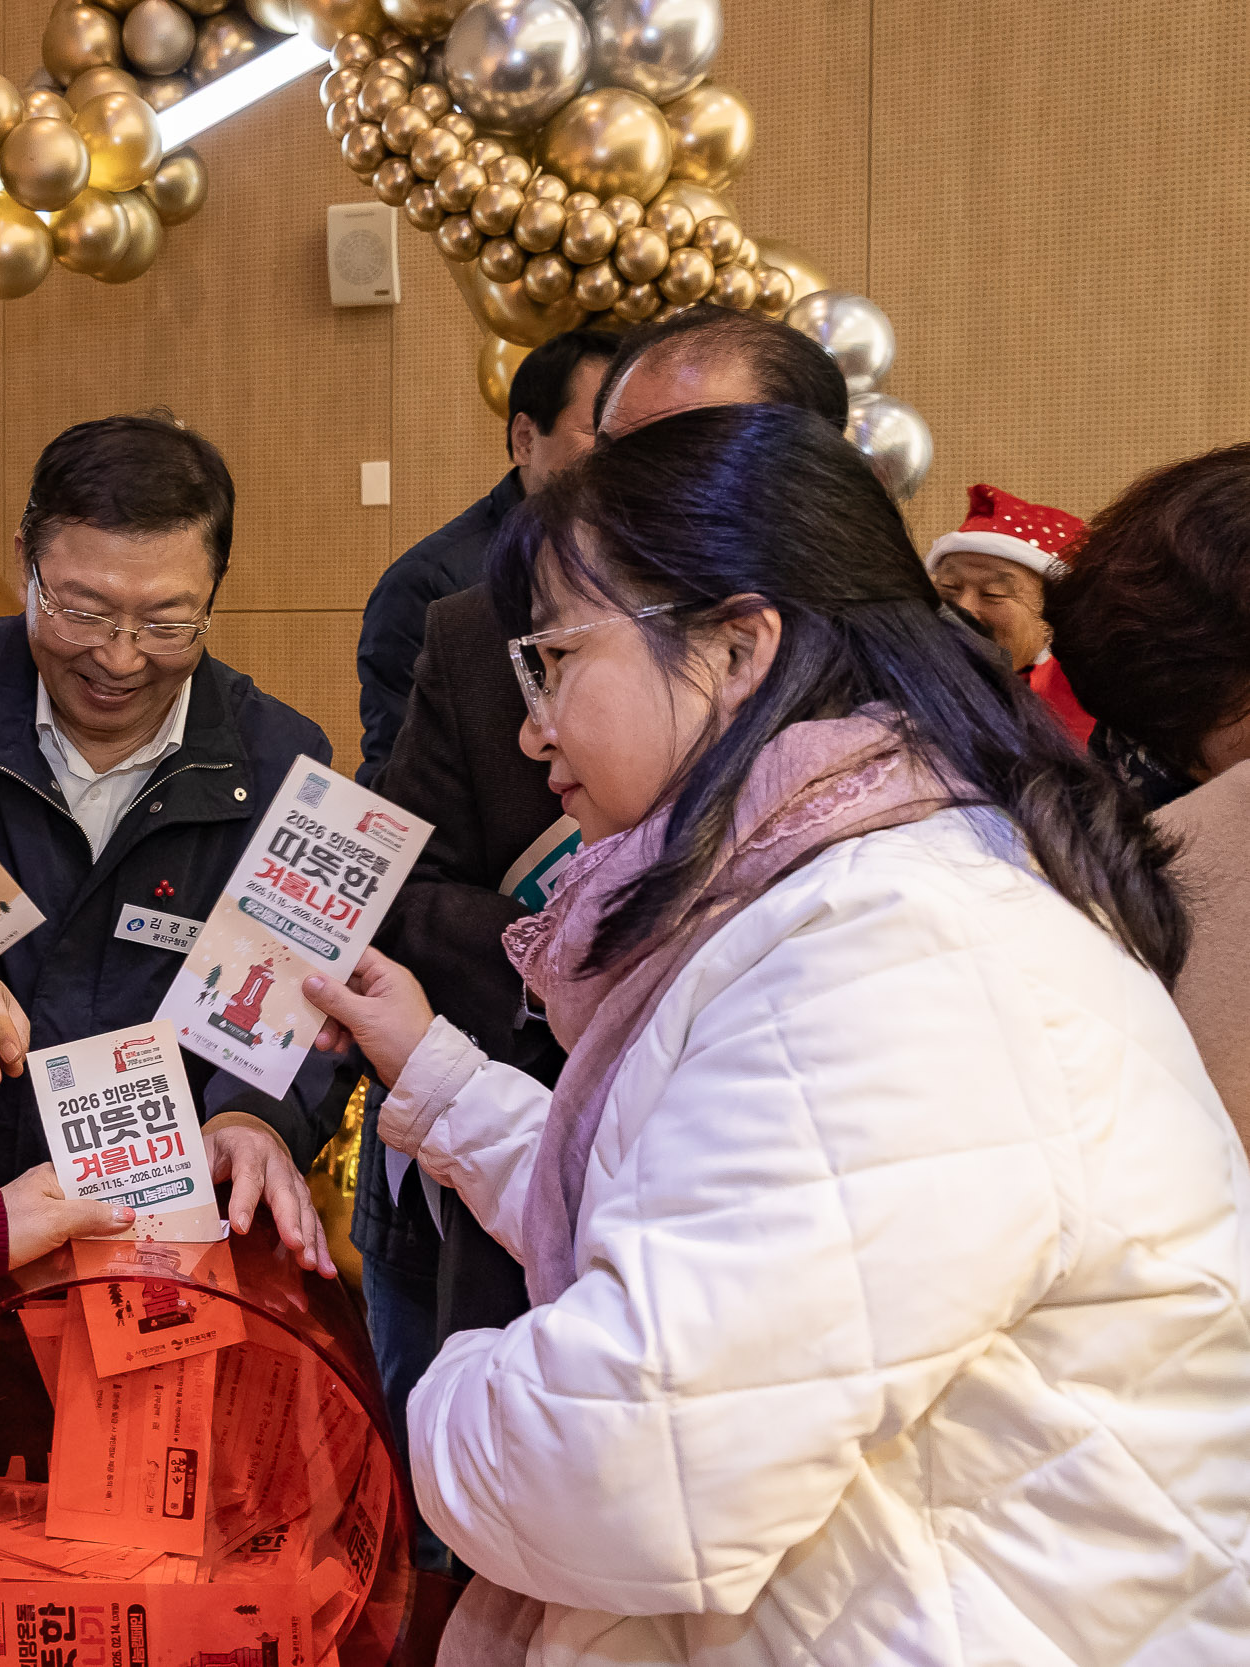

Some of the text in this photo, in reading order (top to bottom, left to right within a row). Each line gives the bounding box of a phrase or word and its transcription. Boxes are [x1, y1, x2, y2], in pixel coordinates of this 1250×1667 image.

[268, 826, 378, 906] 따뜻한
[286, 809, 326, 840] 2026
[326, 832, 392, 876] 희망온돌
[255, 858, 362, 930] 겨울나기
[152, 932, 188, 948] 광진구청장
[58, 1074, 170, 1117] 2026 희망온돌
[62, 1094, 178, 1153] 따뜻한
[72, 1132, 185, 1182] 겨울나기
[136, 1179, 188, 1205] 나눔캠페인
